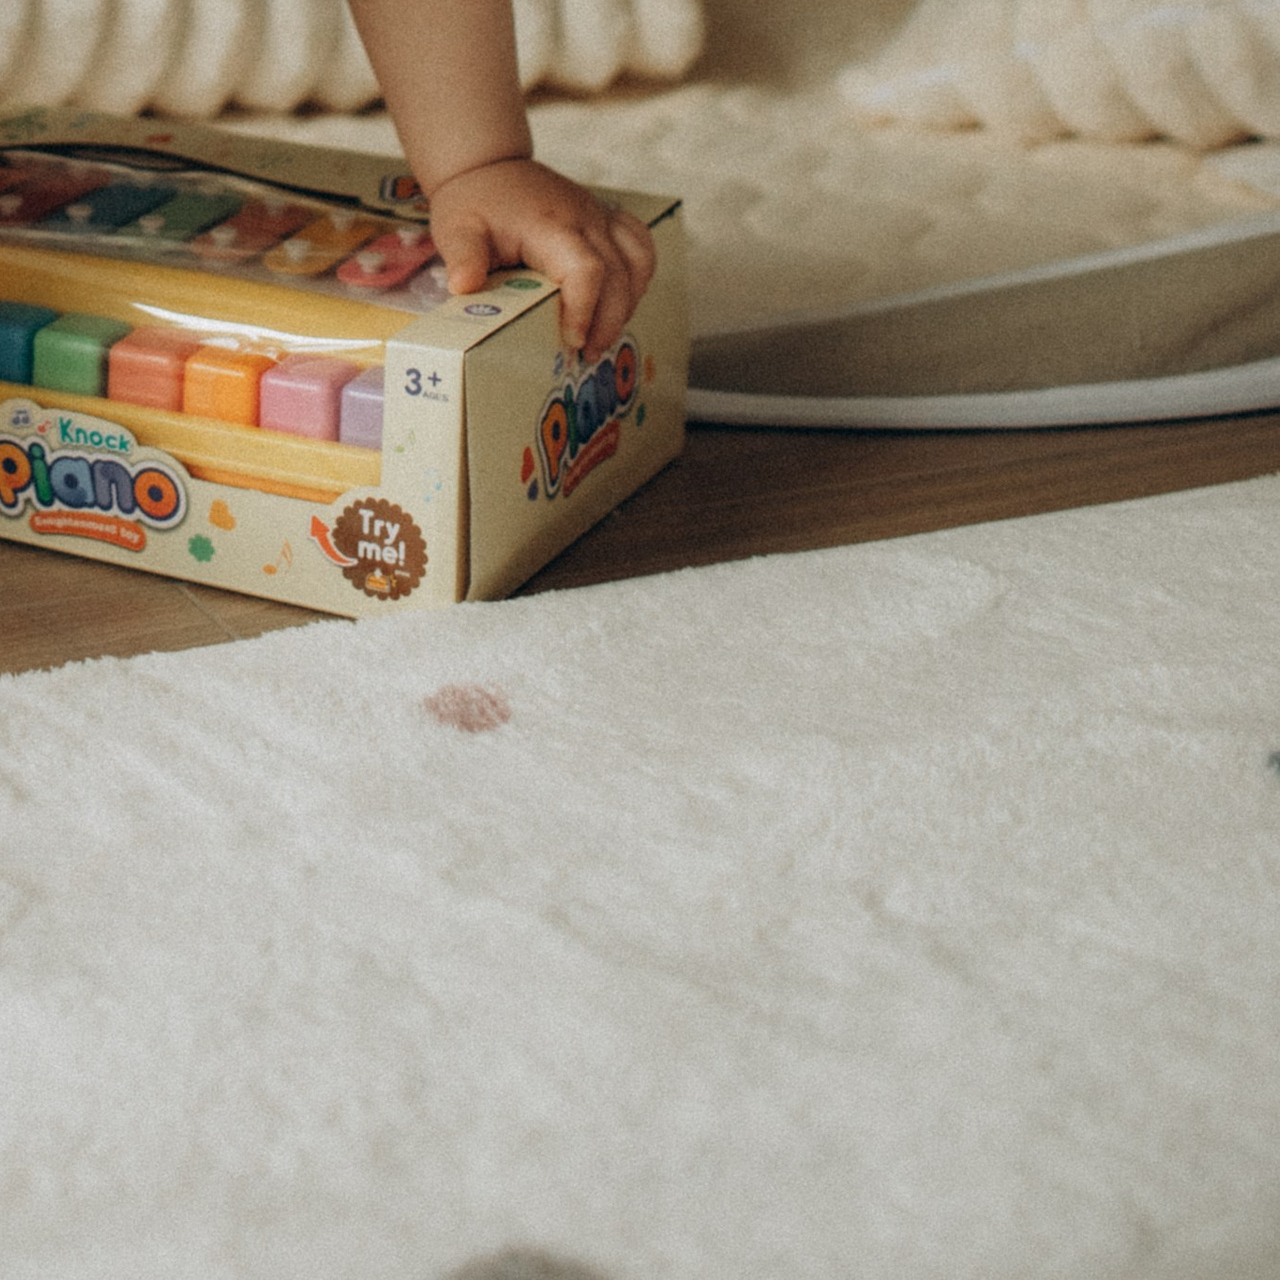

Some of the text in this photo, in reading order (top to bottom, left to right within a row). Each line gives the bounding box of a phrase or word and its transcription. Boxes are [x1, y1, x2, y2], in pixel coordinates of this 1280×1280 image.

[404, 367, 443, 397] 3+
[539, 340, 637, 487] Piano
[58, 416, 131, 453] Knock
[358, 507, 401, 546] Try
[357, 539, 406, 567] me!
